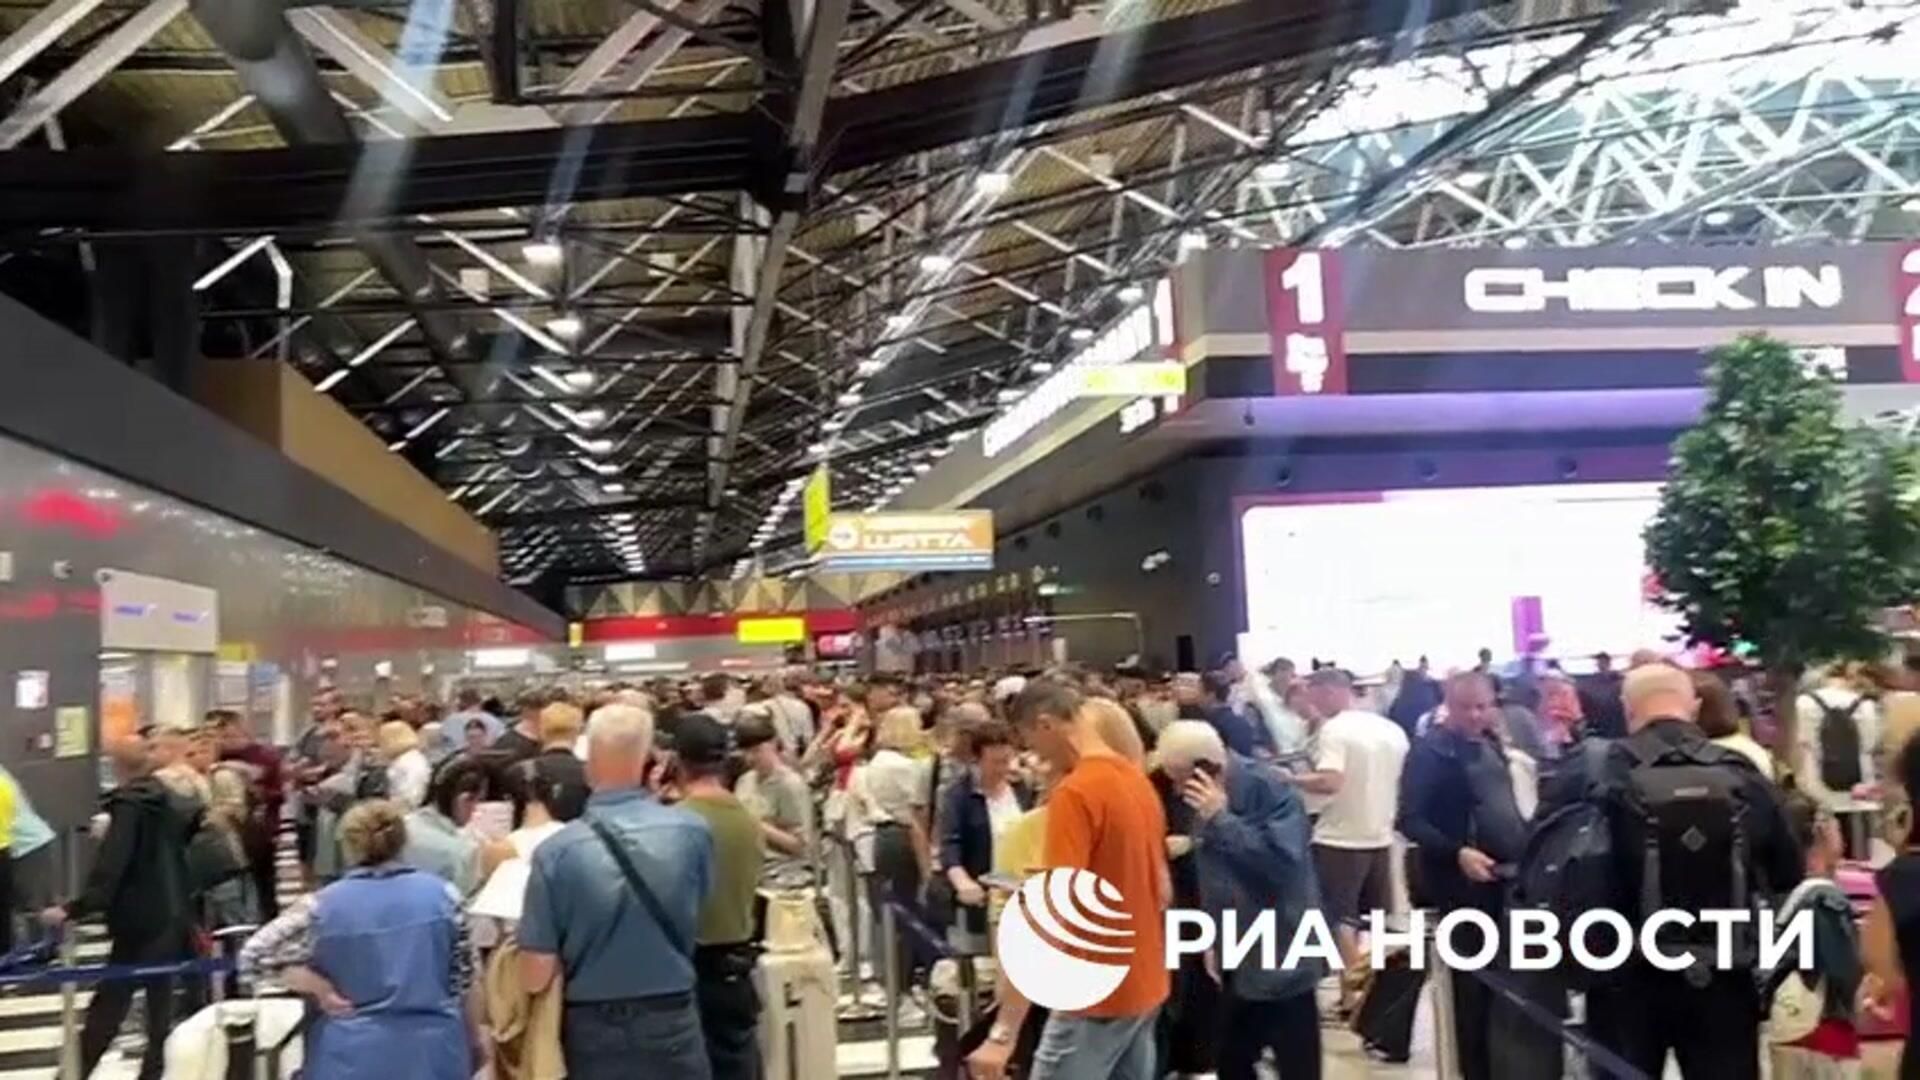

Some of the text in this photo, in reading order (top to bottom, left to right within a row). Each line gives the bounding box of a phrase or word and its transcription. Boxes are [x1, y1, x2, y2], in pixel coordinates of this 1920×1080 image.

[1282, 252, 1324, 324] 1
[1464, 264, 1843, 312] CHECK IN
